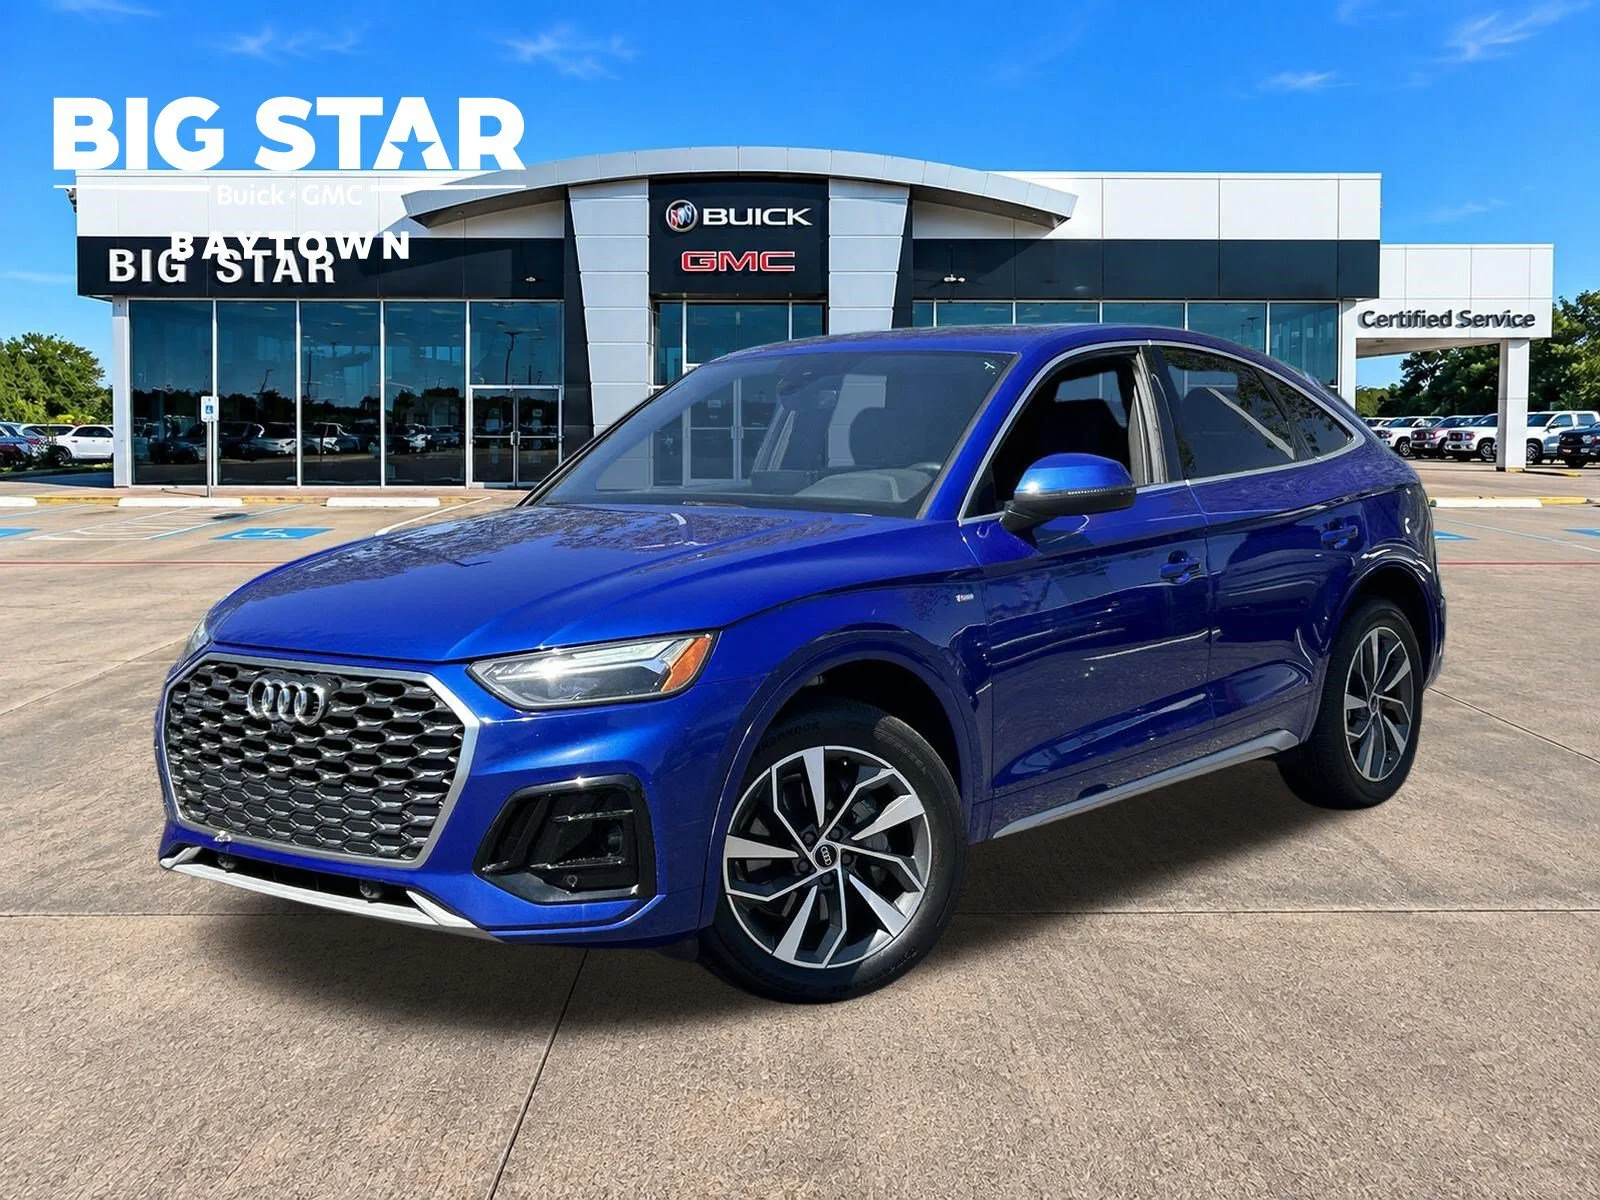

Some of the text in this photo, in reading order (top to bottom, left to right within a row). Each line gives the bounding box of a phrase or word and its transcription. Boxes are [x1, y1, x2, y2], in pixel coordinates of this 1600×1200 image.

[703, 208, 813, 226] BUICK
[109, 249, 336, 283] BIG STAR
[681, 251, 796, 272] GMC
[1361, 309, 1536, 328] Certified Service
